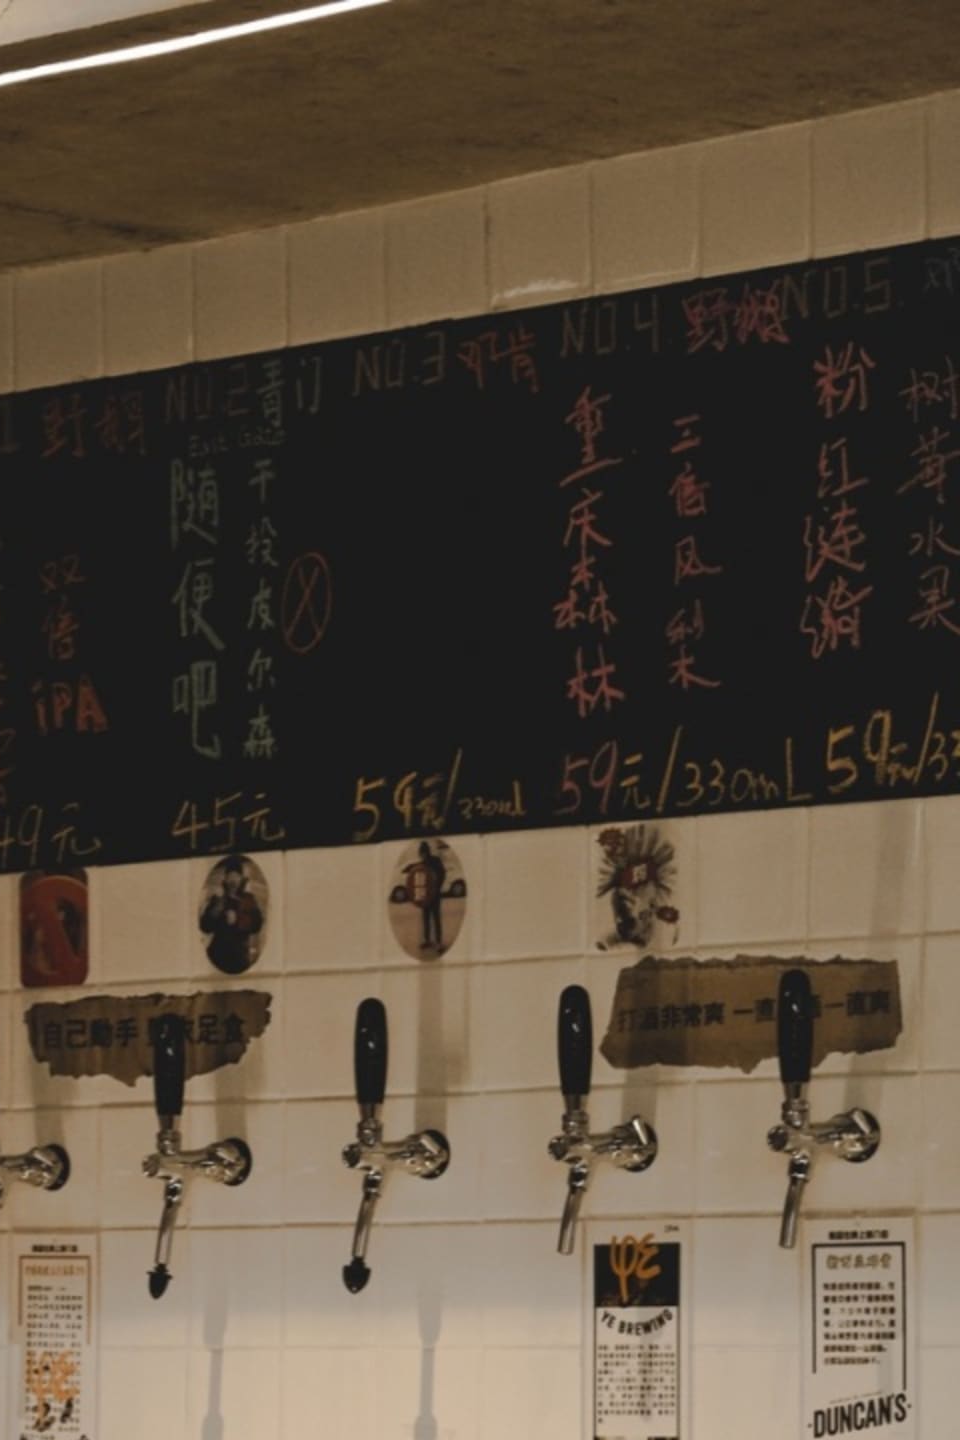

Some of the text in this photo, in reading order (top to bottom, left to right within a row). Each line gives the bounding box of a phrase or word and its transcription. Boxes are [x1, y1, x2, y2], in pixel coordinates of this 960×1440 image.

[553, 385, 626, 718] 重庆森林
[171, 790, 286, 853] 45元
[812, 1392, 907, 1439] DUNCAN'S
